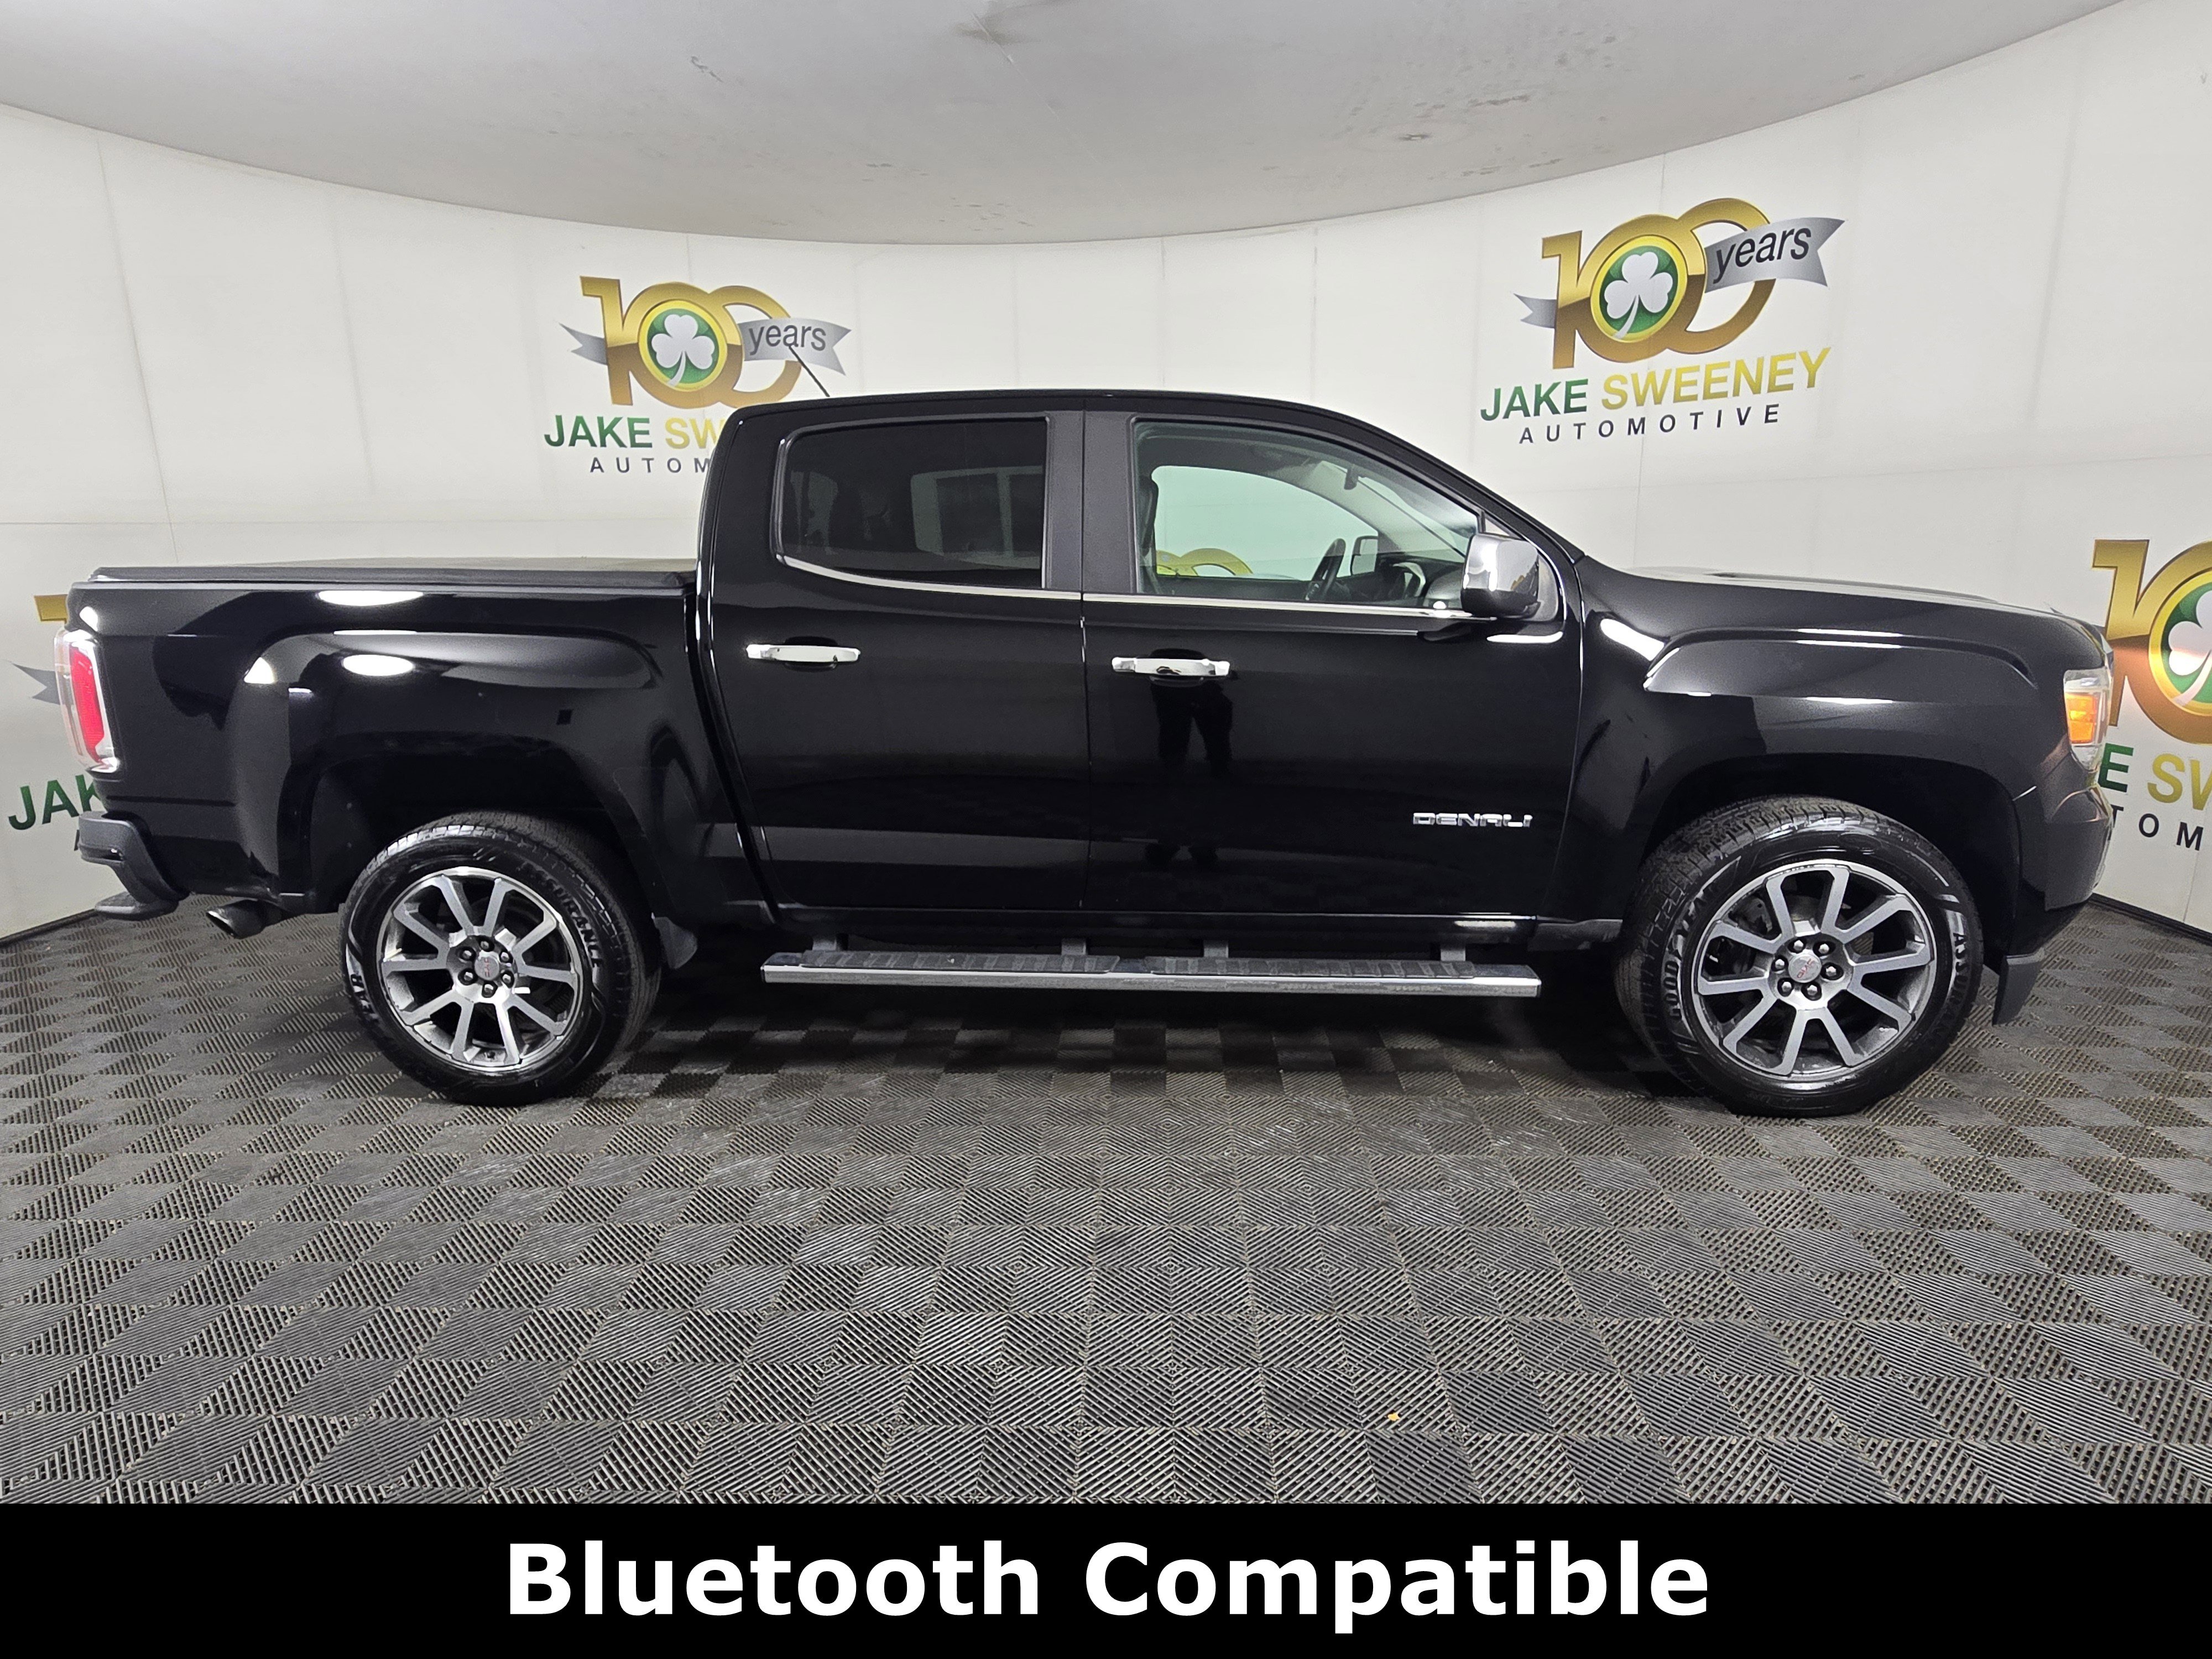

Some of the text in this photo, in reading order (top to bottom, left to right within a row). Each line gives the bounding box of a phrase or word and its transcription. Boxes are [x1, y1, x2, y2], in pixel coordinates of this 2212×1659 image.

[1713, 226, 1812, 283] years
[748, 324, 827, 356] years
[1480, 347, 1832, 421] JAKE SWEENEY
[544, 414, 653, 450] JAKE
[1519, 403, 1780, 444] AUTOMOTIVE
[589, 457, 711, 473] AUTOM
[8, 774, 104, 831] JAK
[1412, 812, 1533, 827] DENALI
